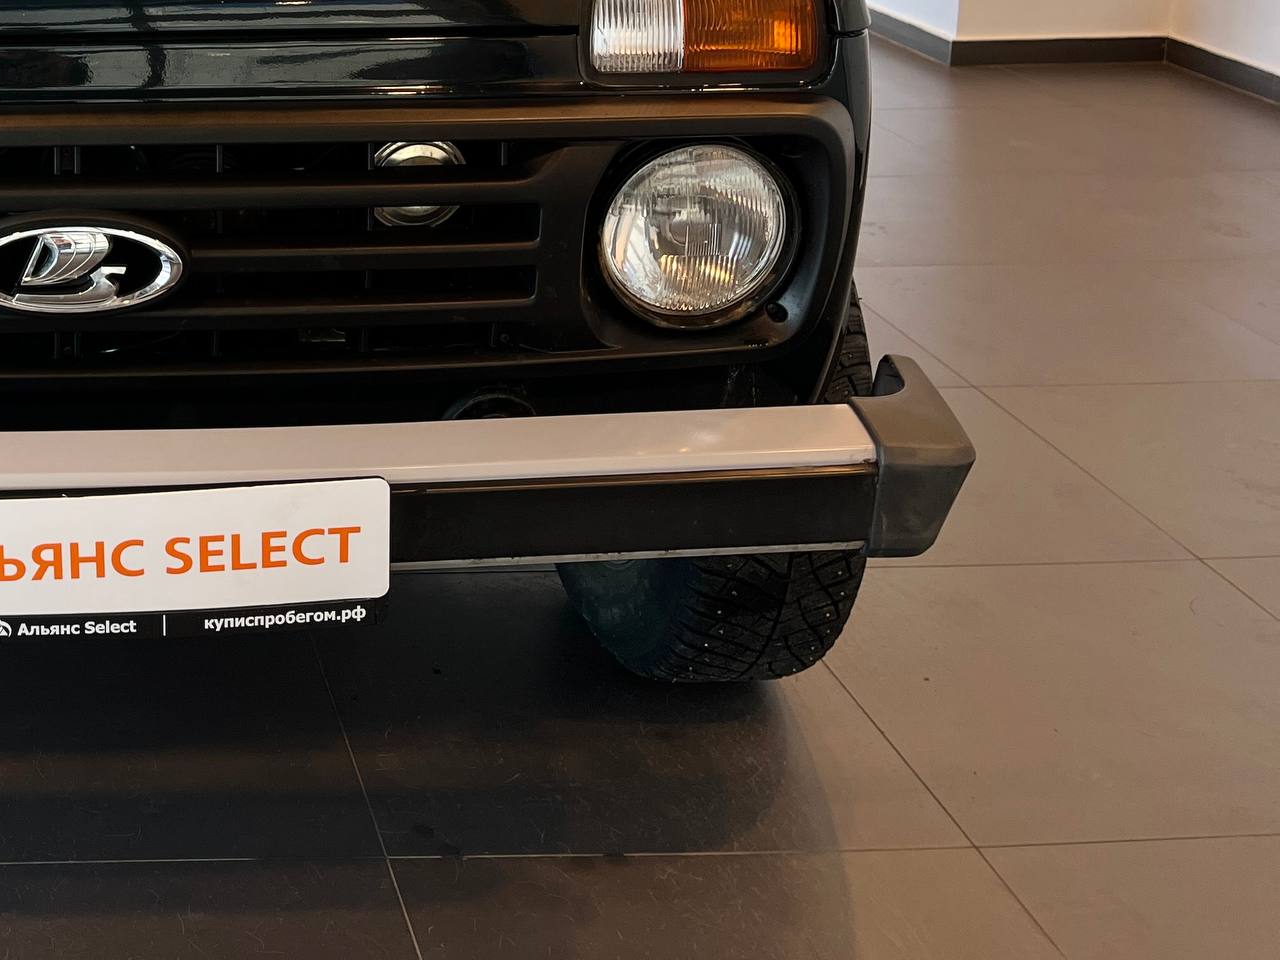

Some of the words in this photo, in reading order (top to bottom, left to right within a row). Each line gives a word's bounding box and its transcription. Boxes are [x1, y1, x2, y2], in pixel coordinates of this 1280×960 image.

[164, 525, 362, 576] SELECT
[17, 622, 81, 637] Альянс
[84, 620, 137, 635] Select
[203, 605, 367, 632] куписпробегом.рф
